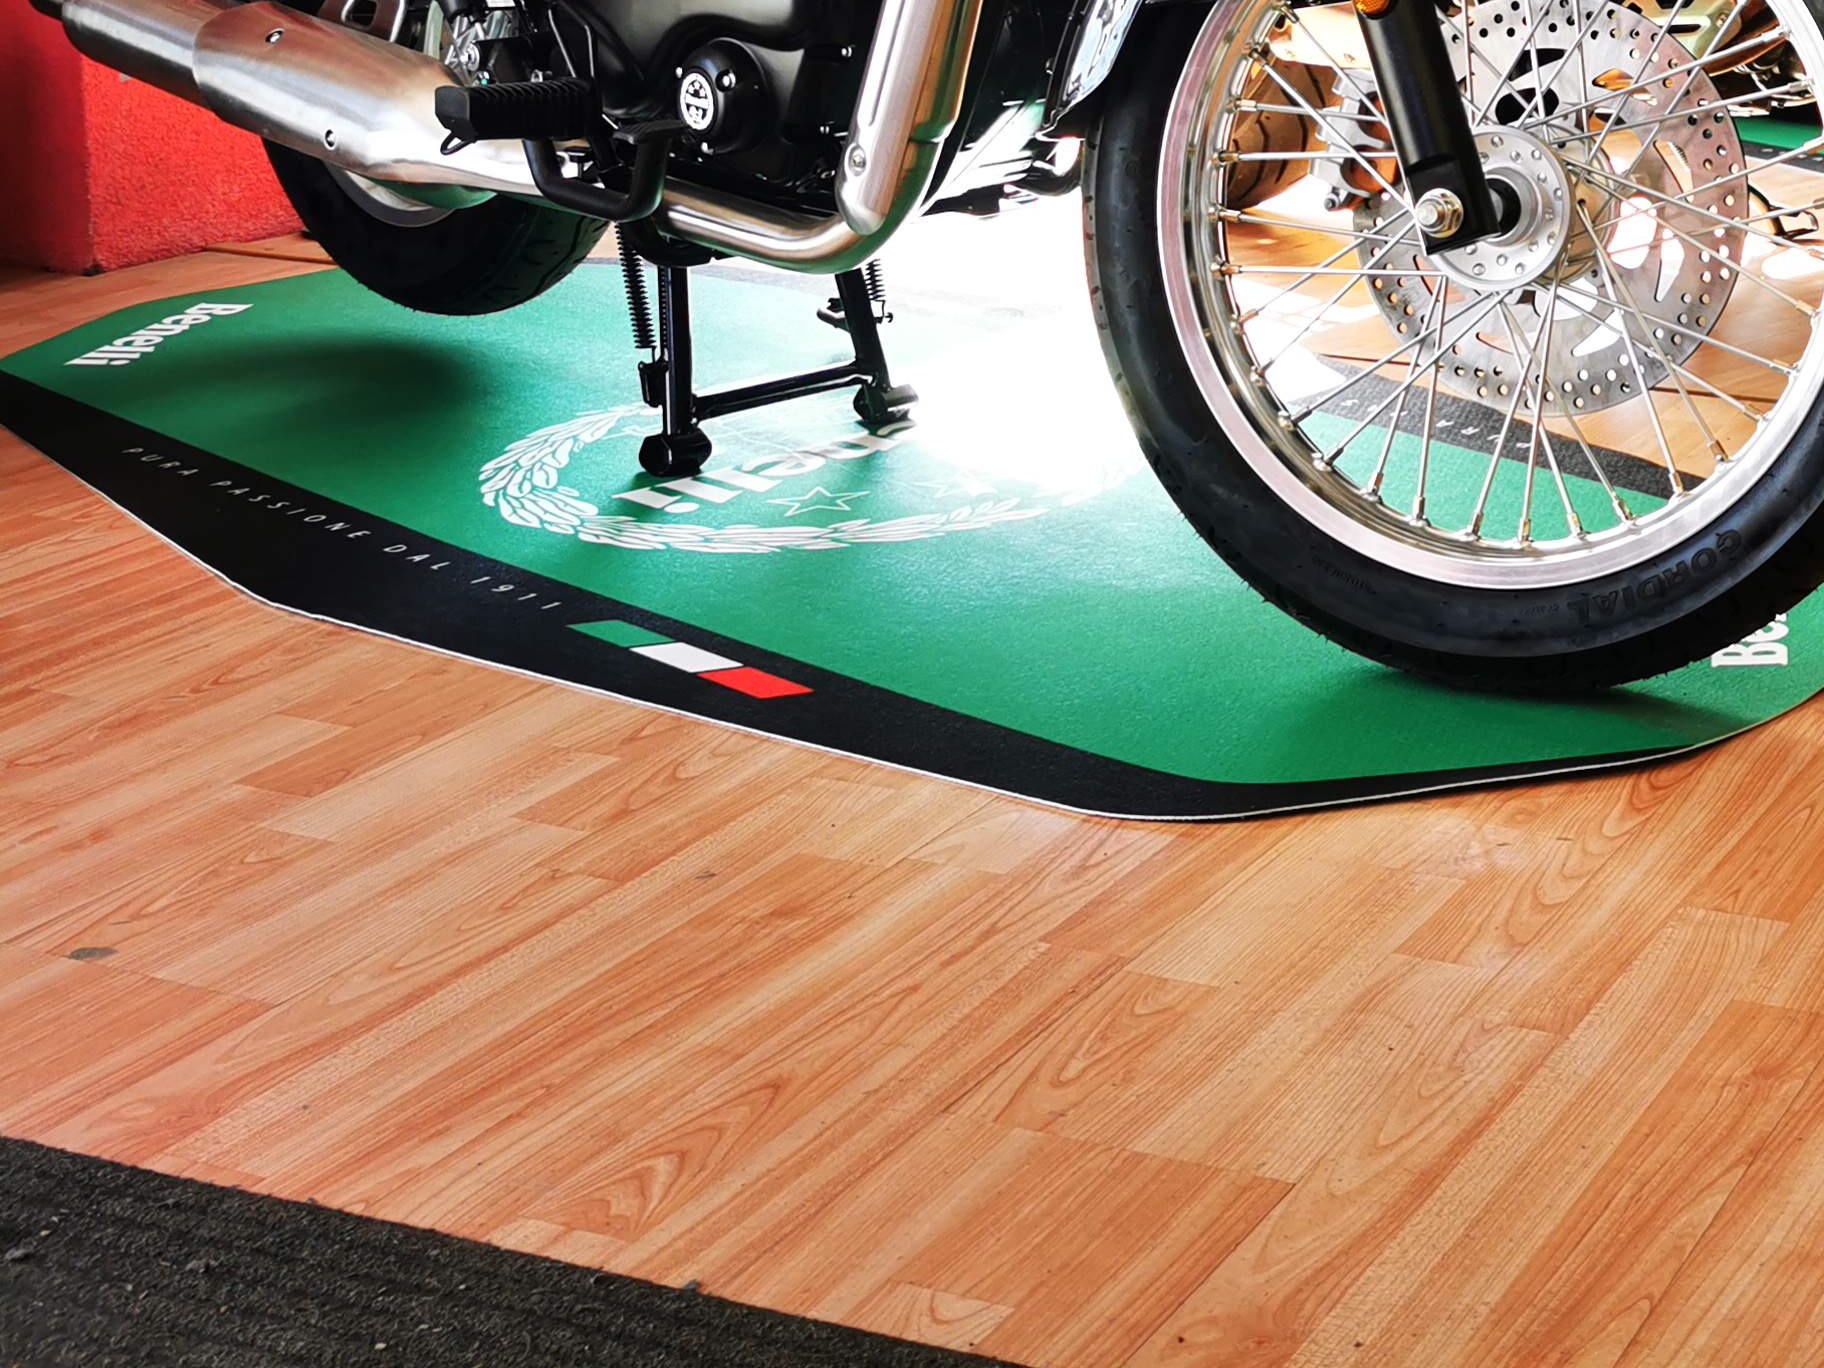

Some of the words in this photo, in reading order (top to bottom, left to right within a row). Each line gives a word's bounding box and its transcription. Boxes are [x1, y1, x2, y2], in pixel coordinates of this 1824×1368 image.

[64, 302, 255, 366] Benelli
[122, 446, 198, 477] PURA
[210, 480, 371, 540] PASSIONE
[382, 543, 451, 571] DAL
[470, 575, 562, 611] 1911
[1566, 528, 1742, 623] CORDIAL
